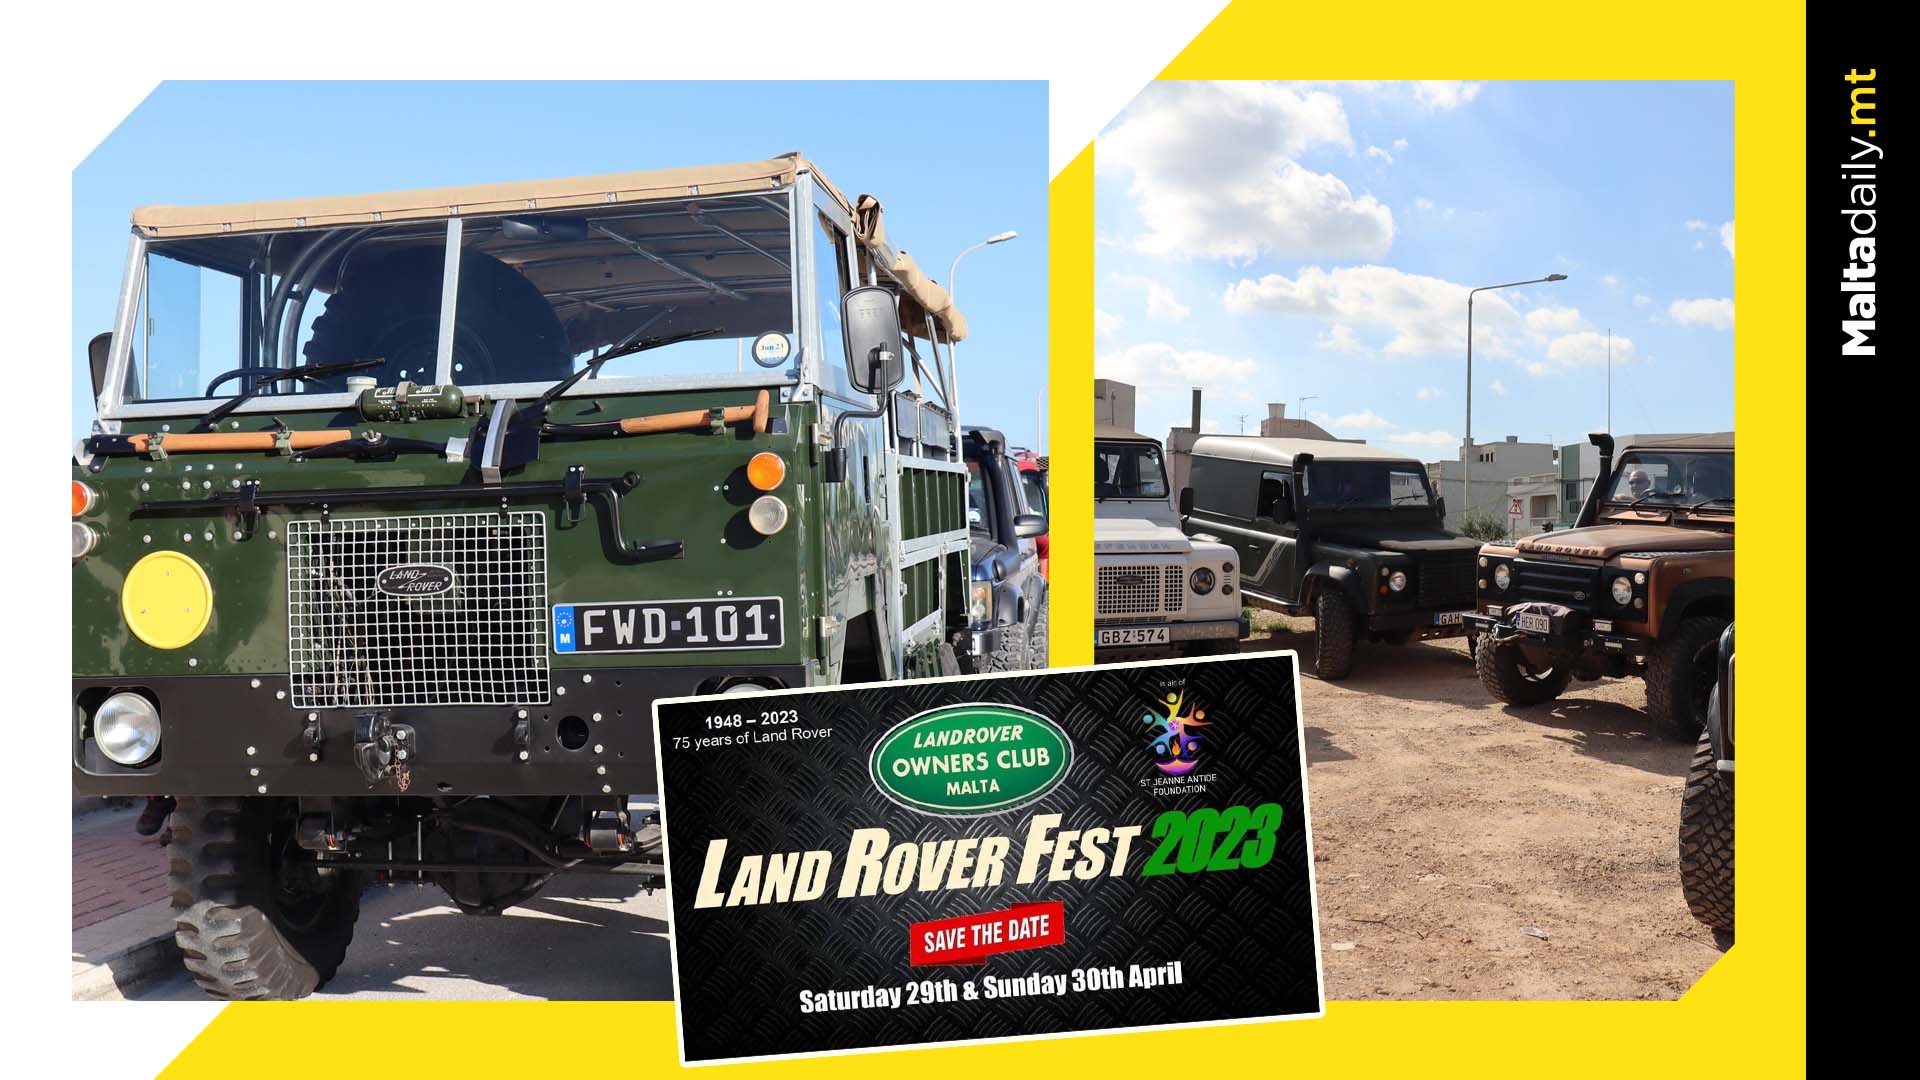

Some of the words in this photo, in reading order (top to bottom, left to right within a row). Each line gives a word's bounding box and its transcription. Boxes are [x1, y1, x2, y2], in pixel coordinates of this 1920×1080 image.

[389, 569, 419, 580] LAND
[406, 581, 442, 592] ROVER
[559, 633, 571, 644] M
